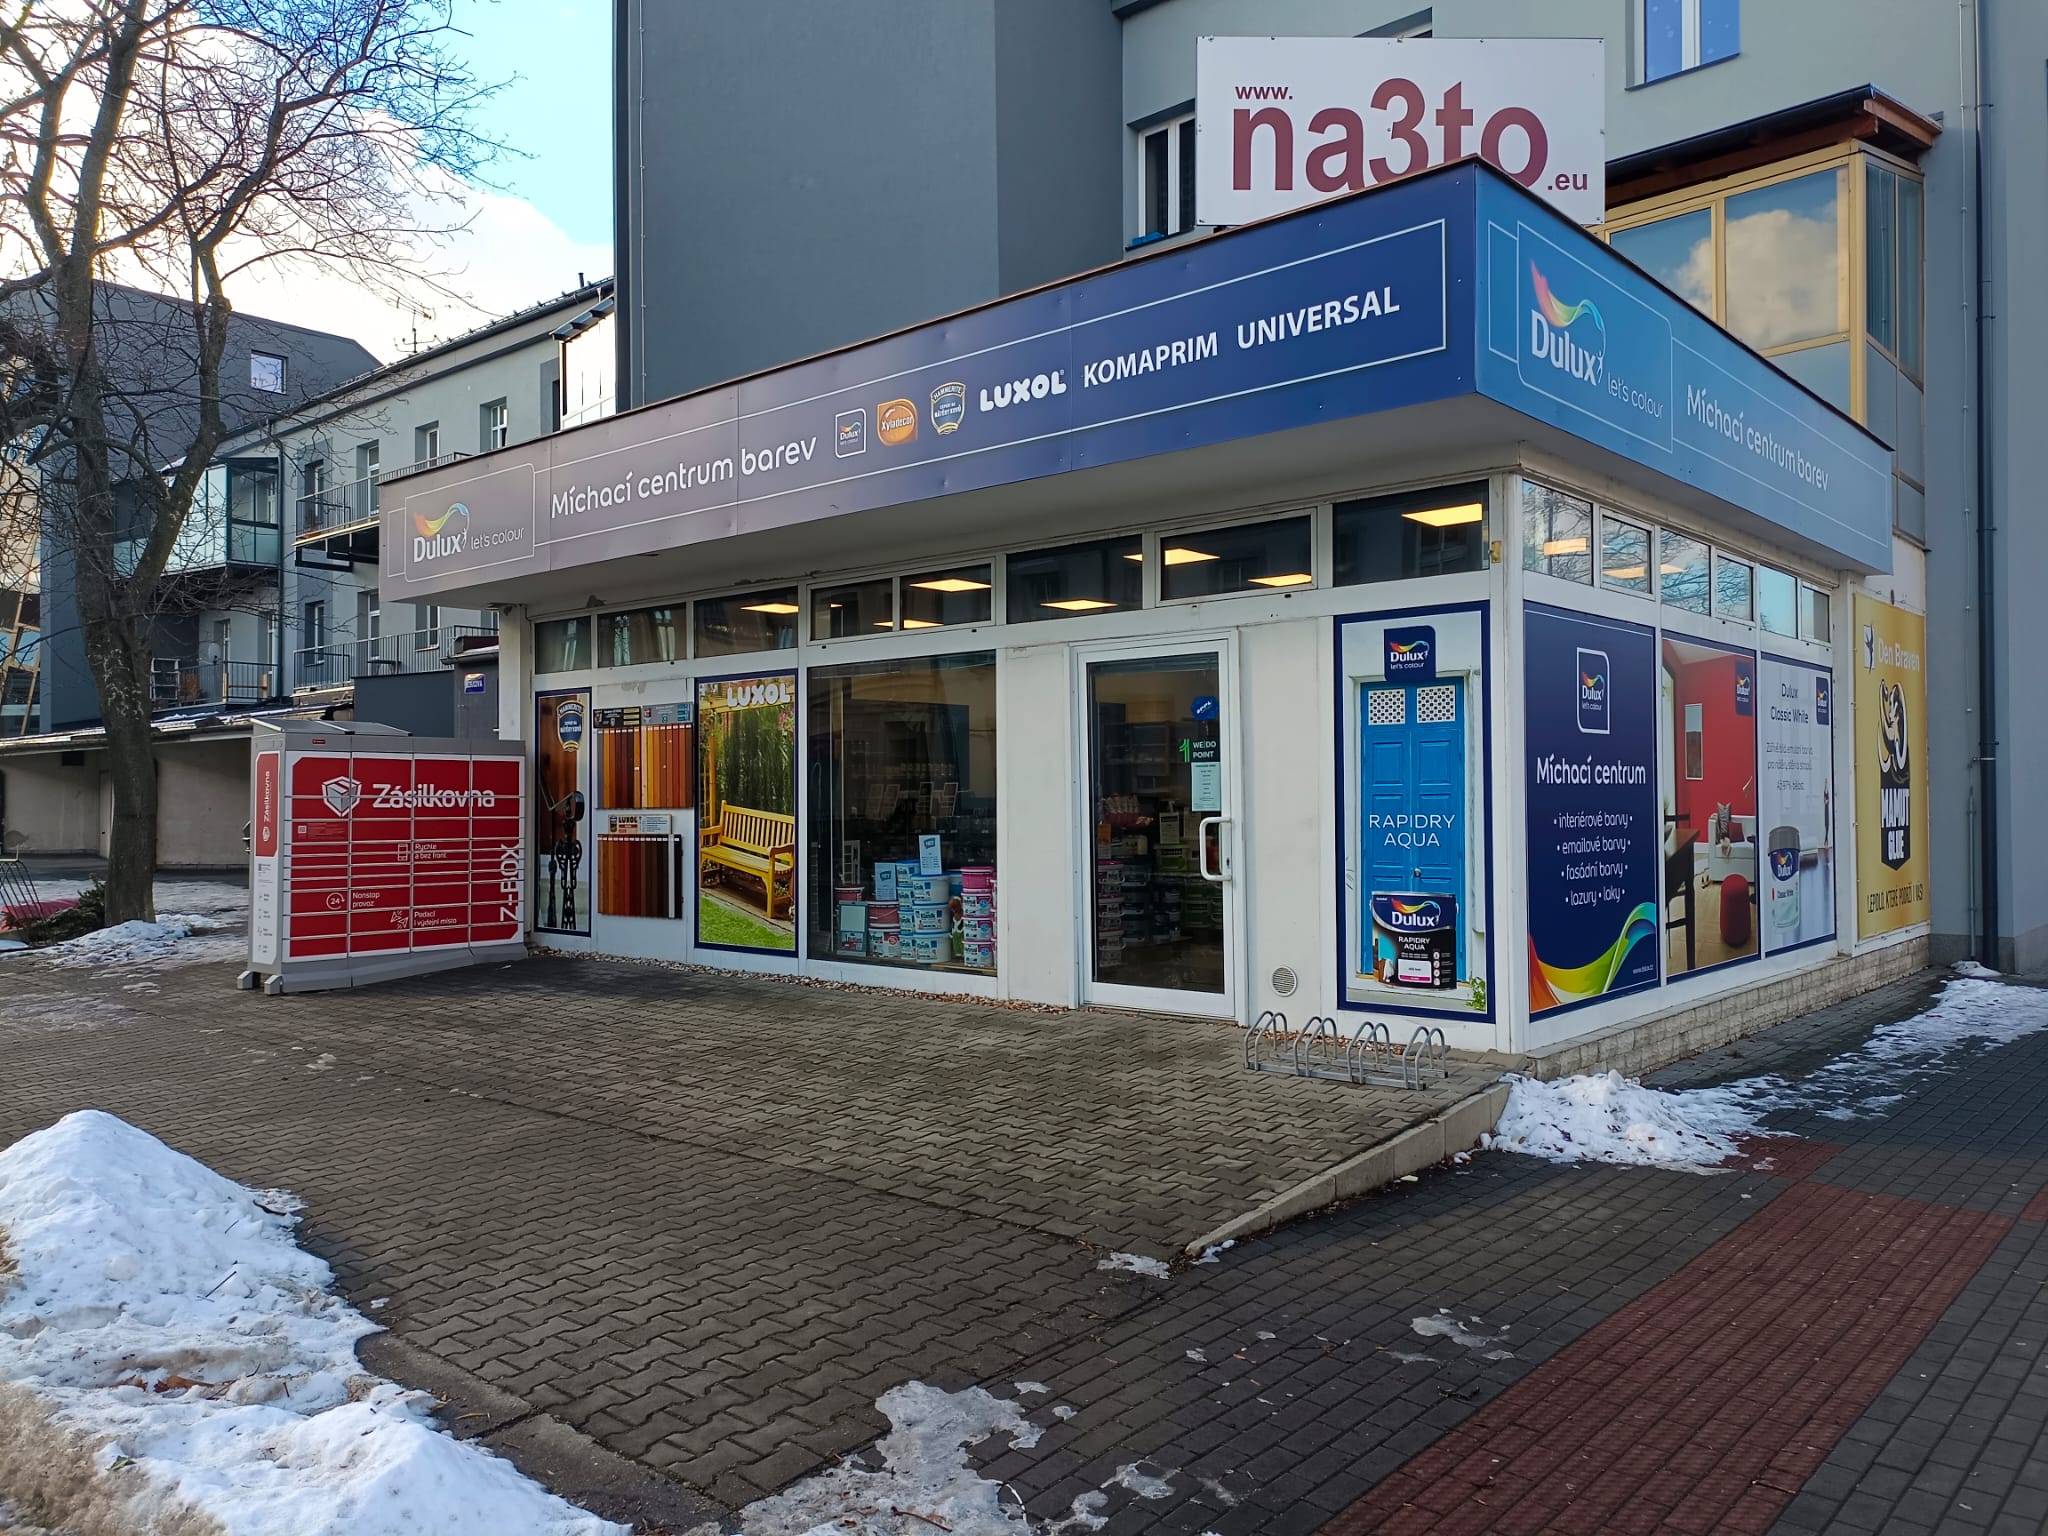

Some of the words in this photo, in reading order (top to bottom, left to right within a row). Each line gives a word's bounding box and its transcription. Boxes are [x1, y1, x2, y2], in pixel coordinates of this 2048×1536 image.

[1235, 86, 1293, 100] www.
[1236, 285, 1401, 351] UNIVERSAL
[1531, 308, 1598, 386] Dulux
[1082, 332, 1219, 388] KOMAPRIM
[979, 371, 1067, 413] LUXOL
[1631, 388, 1663, 420] colour
[1686, 383, 1744, 445] Míchací
[1747, 426, 1796, 470] centrum
[1797, 449, 1829, 492] barev
[551, 470, 631, 519] Míchací
[638, 456, 734, 497] centrum
[741, 436, 817, 476] barev
[492, 526, 524, 546] colour
[413, 533, 462, 564] Dulux
[1390, 651, 1424, 663] Dulux
[1878, 637, 1894, 666] Den
[1894, 642, 1920, 673] Braven
[726, 683, 791, 708] LUXOL
[1582, 684, 1602, 701] Dulux
[1781, 683, 1798, 699] Dulux
[1770, 705, 1792, 722] Classic
[1792, 708, 1809, 724] White
[1192, 750, 1215, 759] POINT
[1536, 753, 1592, 786] Míchací
[1594, 758, 1646, 786] centrum
[372, 783, 496, 810] Zásilkovna
[1881, 787, 1910, 829] MAMUT
[1368, 813, 1456, 829] RAPIDRY
[1559, 810, 1603, 829] interiérové
[1604, 811, 1629, 829] barvy
[414, 843, 437, 853] Rychle
[1383, 832, 1441, 849] AQUA
[1562, 835, 1601, 855] emailové
[1602, 835, 1626, 854] barvy
[1887, 829, 1905, 861] GLUE
[1566, 861, 1598, 881] fasádní
[1600, 860, 1623, 878] barvy
[500, 843, 520, 922] Z-BOX
[352, 891, 381, 901] Nonstop
[352, 900, 375, 909] provoz
[1570, 890, 1597, 907] lazury
[1603, 885, 1621, 903] laky
[414, 910, 436, 919] Podací
[1391, 911, 1435, 927] Dulux
[1398, 935, 1431, 944] RAPIDRY
[1403, 943, 1426, 951] AQUA
